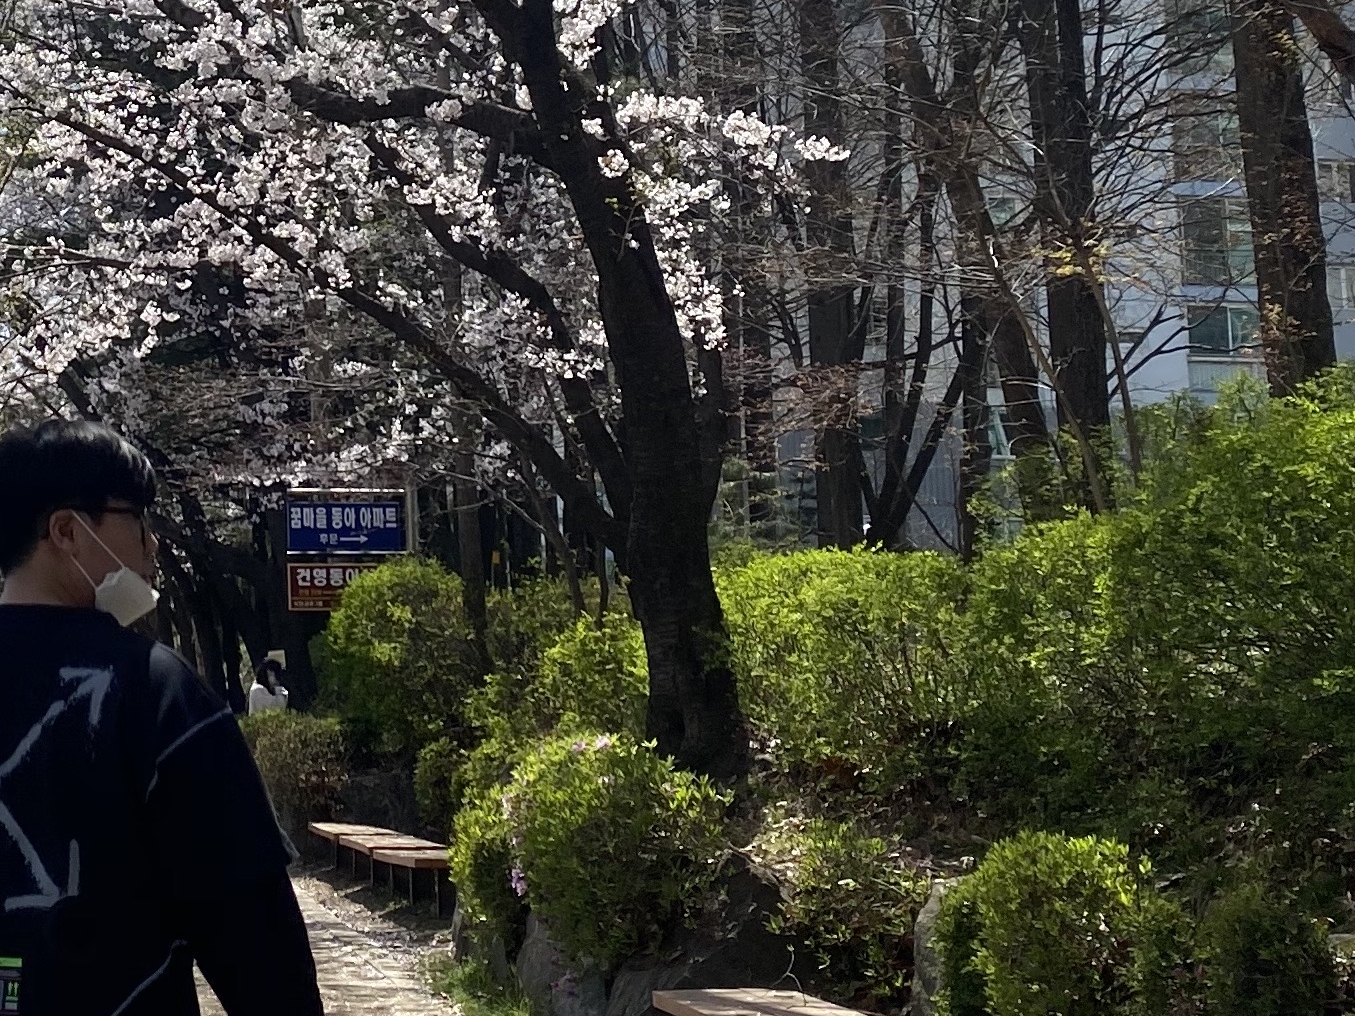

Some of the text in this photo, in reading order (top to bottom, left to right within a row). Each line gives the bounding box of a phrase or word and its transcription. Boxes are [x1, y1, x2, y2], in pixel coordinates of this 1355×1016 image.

[290, 507, 397, 529] 꿈마을 동아 아파트
[319, 533, 338, 545] 후문
